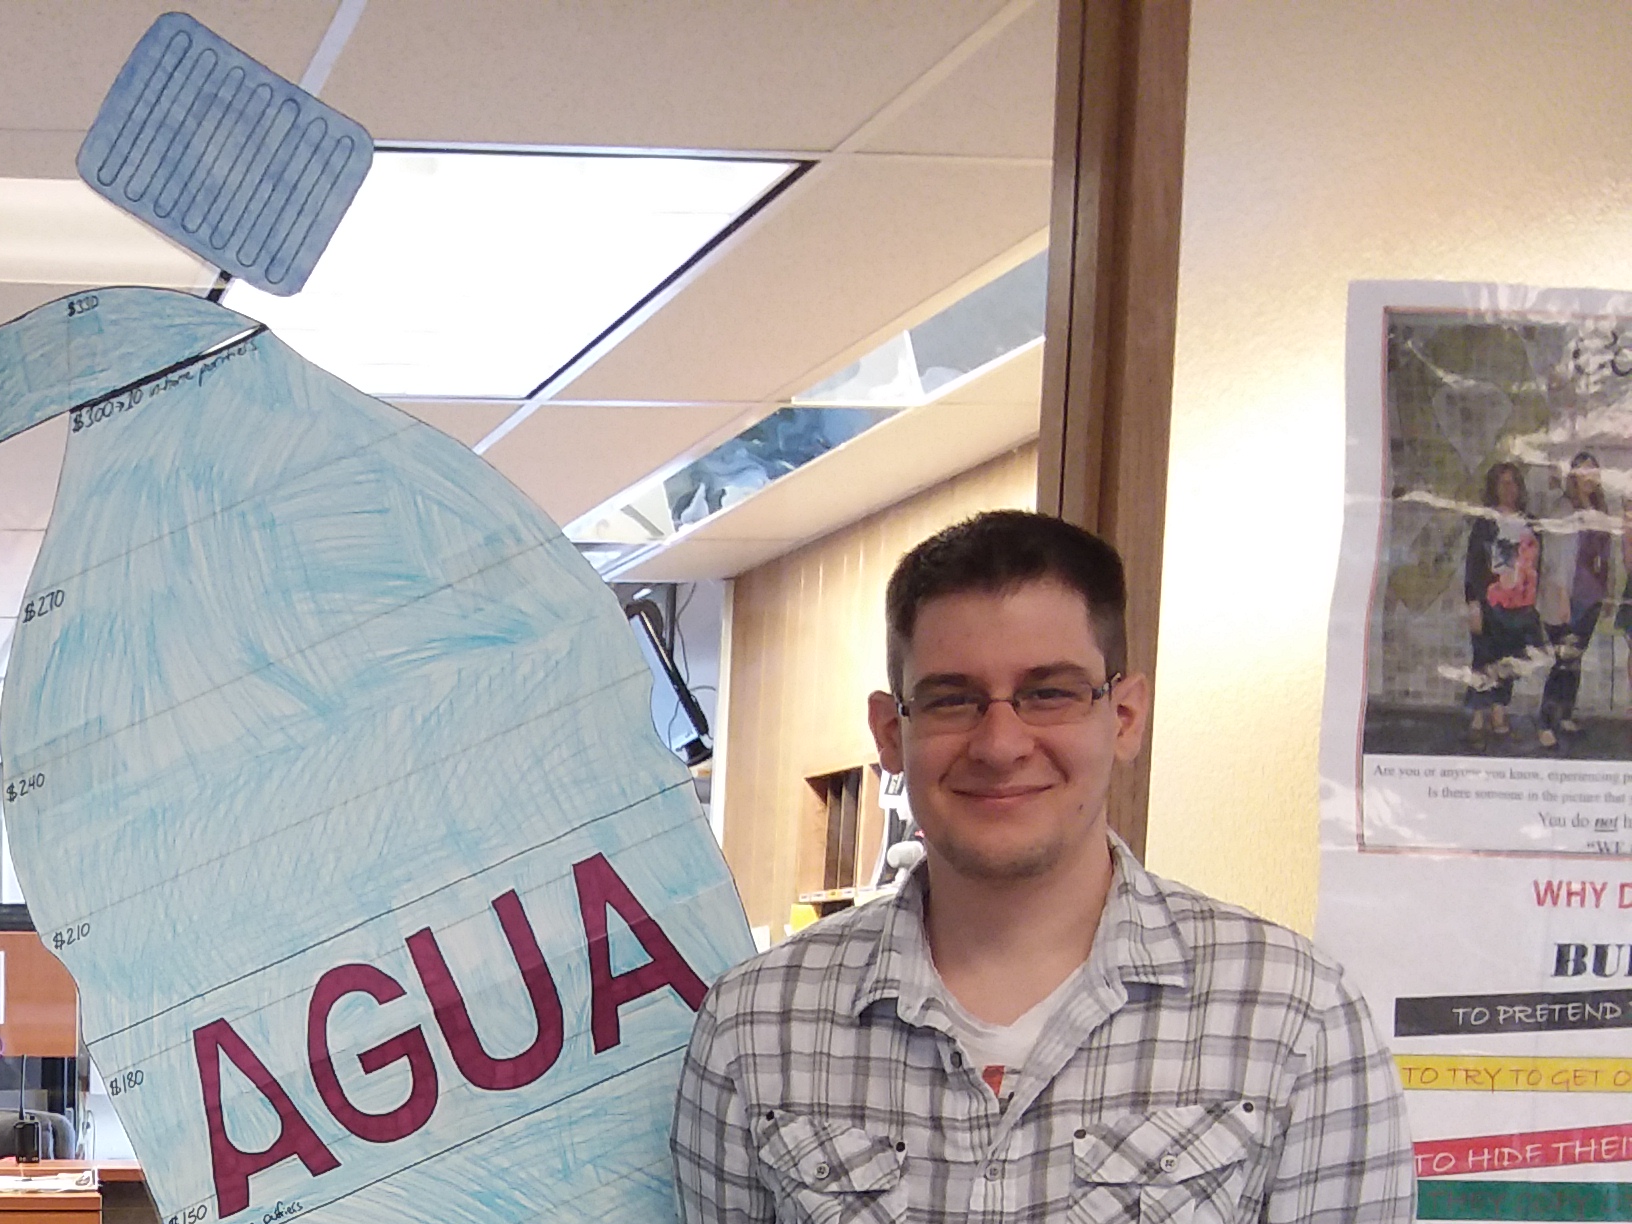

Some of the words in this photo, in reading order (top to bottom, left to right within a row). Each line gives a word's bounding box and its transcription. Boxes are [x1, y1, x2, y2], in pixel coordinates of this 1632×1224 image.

[68, 295, 99, 317] $330
[72, 402, 113, 433] $300
[23, 589, 65, 623] $270
[7, 772, 45, 802] $240
[1572, 812, 1589, 828] do
[1533, 880, 1608, 909] WHY
[53, 922, 90, 950] $210
[1452, 1007, 1490, 1026] TO
[1496, 1002, 1622, 1025] PRETEND
[192, 852, 709, 1219] AGUA
[109, 1070, 144, 1096] $180
[1402, 1067, 1438, 1084] TO
[1447, 1068, 1502, 1094] TRY
[1509, 1069, 1543, 1086] TO
[1551, 1069, 1606, 1092] GET
[1414, 1152, 1455, 1174] TO
[1468, 1144, 1542, 1170] HIDE
[1551, 1136, 1632, 1165] THEI
[1427, 1190, 1507, 1220] THEY
